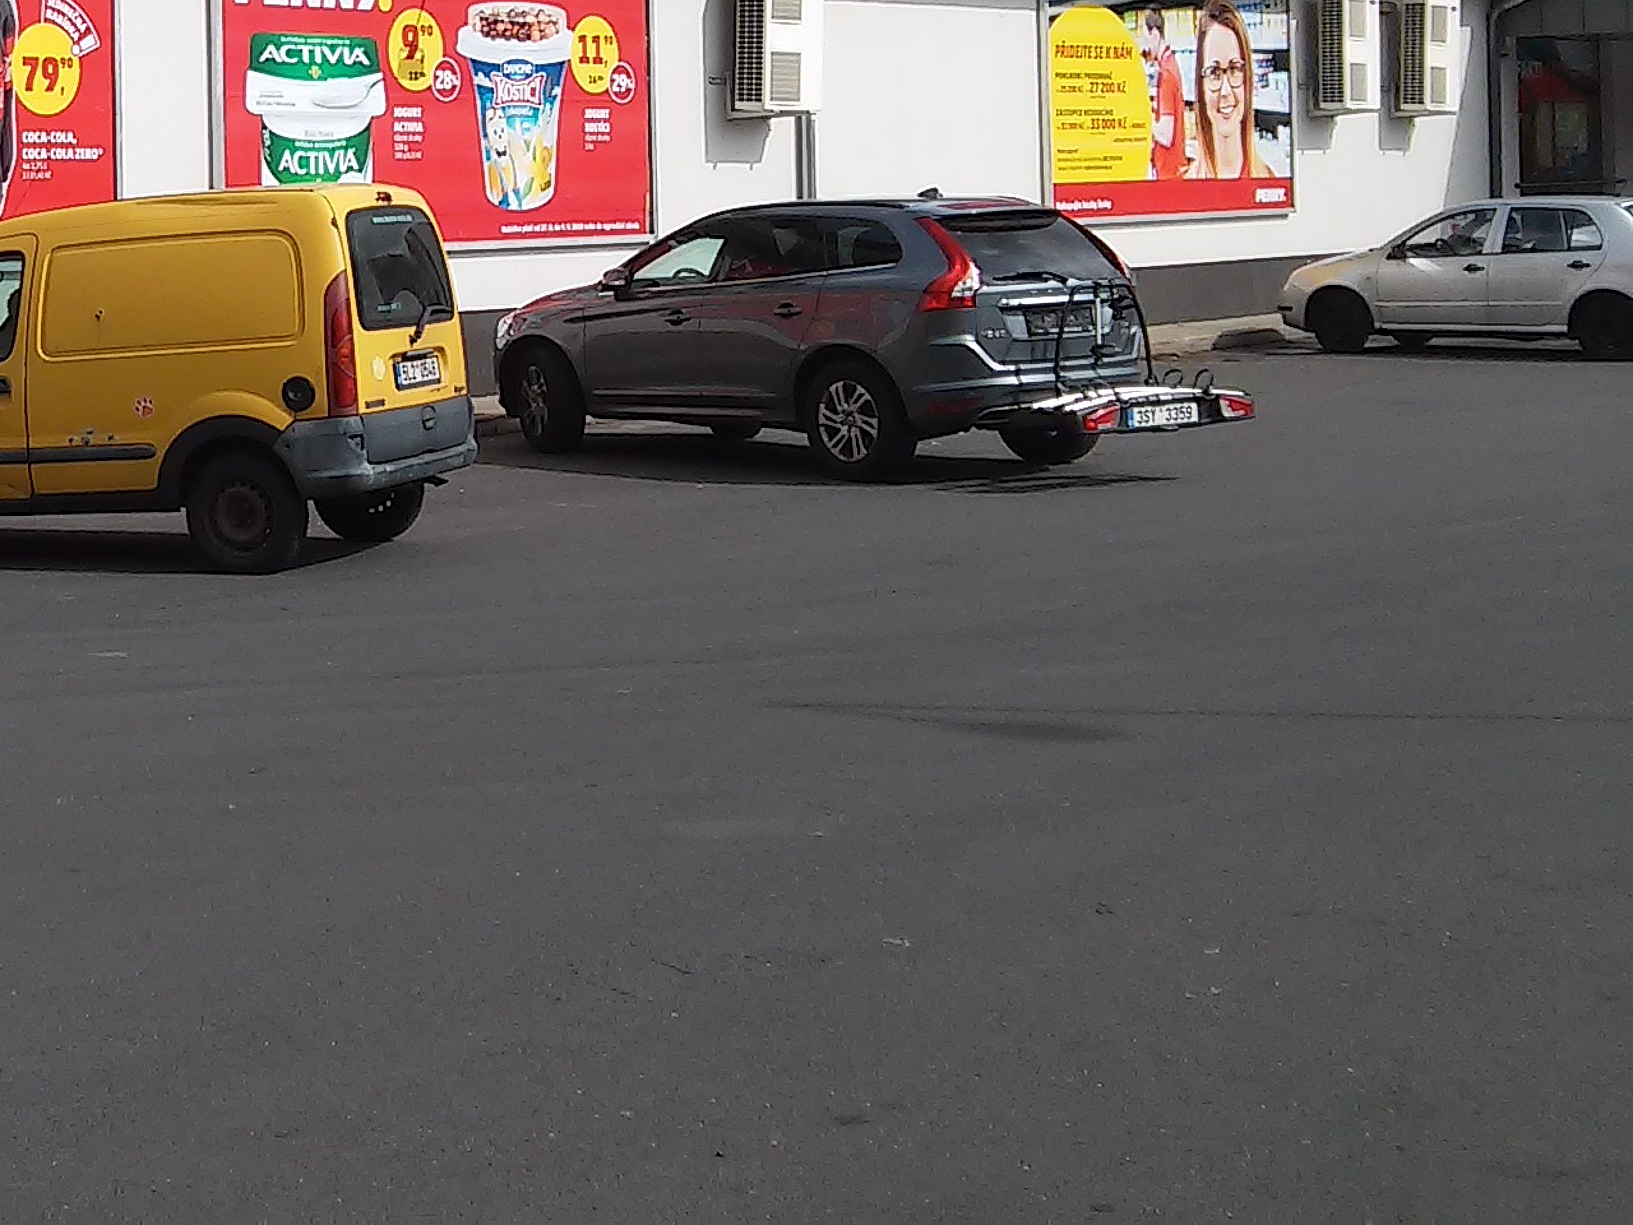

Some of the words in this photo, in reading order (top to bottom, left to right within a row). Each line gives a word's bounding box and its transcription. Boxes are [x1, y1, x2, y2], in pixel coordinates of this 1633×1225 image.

[259, 43, 371, 66] ACTIVIA
[1054, 40, 1093, 59] PŘIDEJTE
[1113, 42, 1133, 60] NÁM
[434, 69, 459, 90] 28%
[611, 73, 634, 93] 29%
[22, 146, 74, 161] COCA-COLA
[277, 147, 360, 176] ACTIVIA
[1164, 405, 1193, 423] 3359
